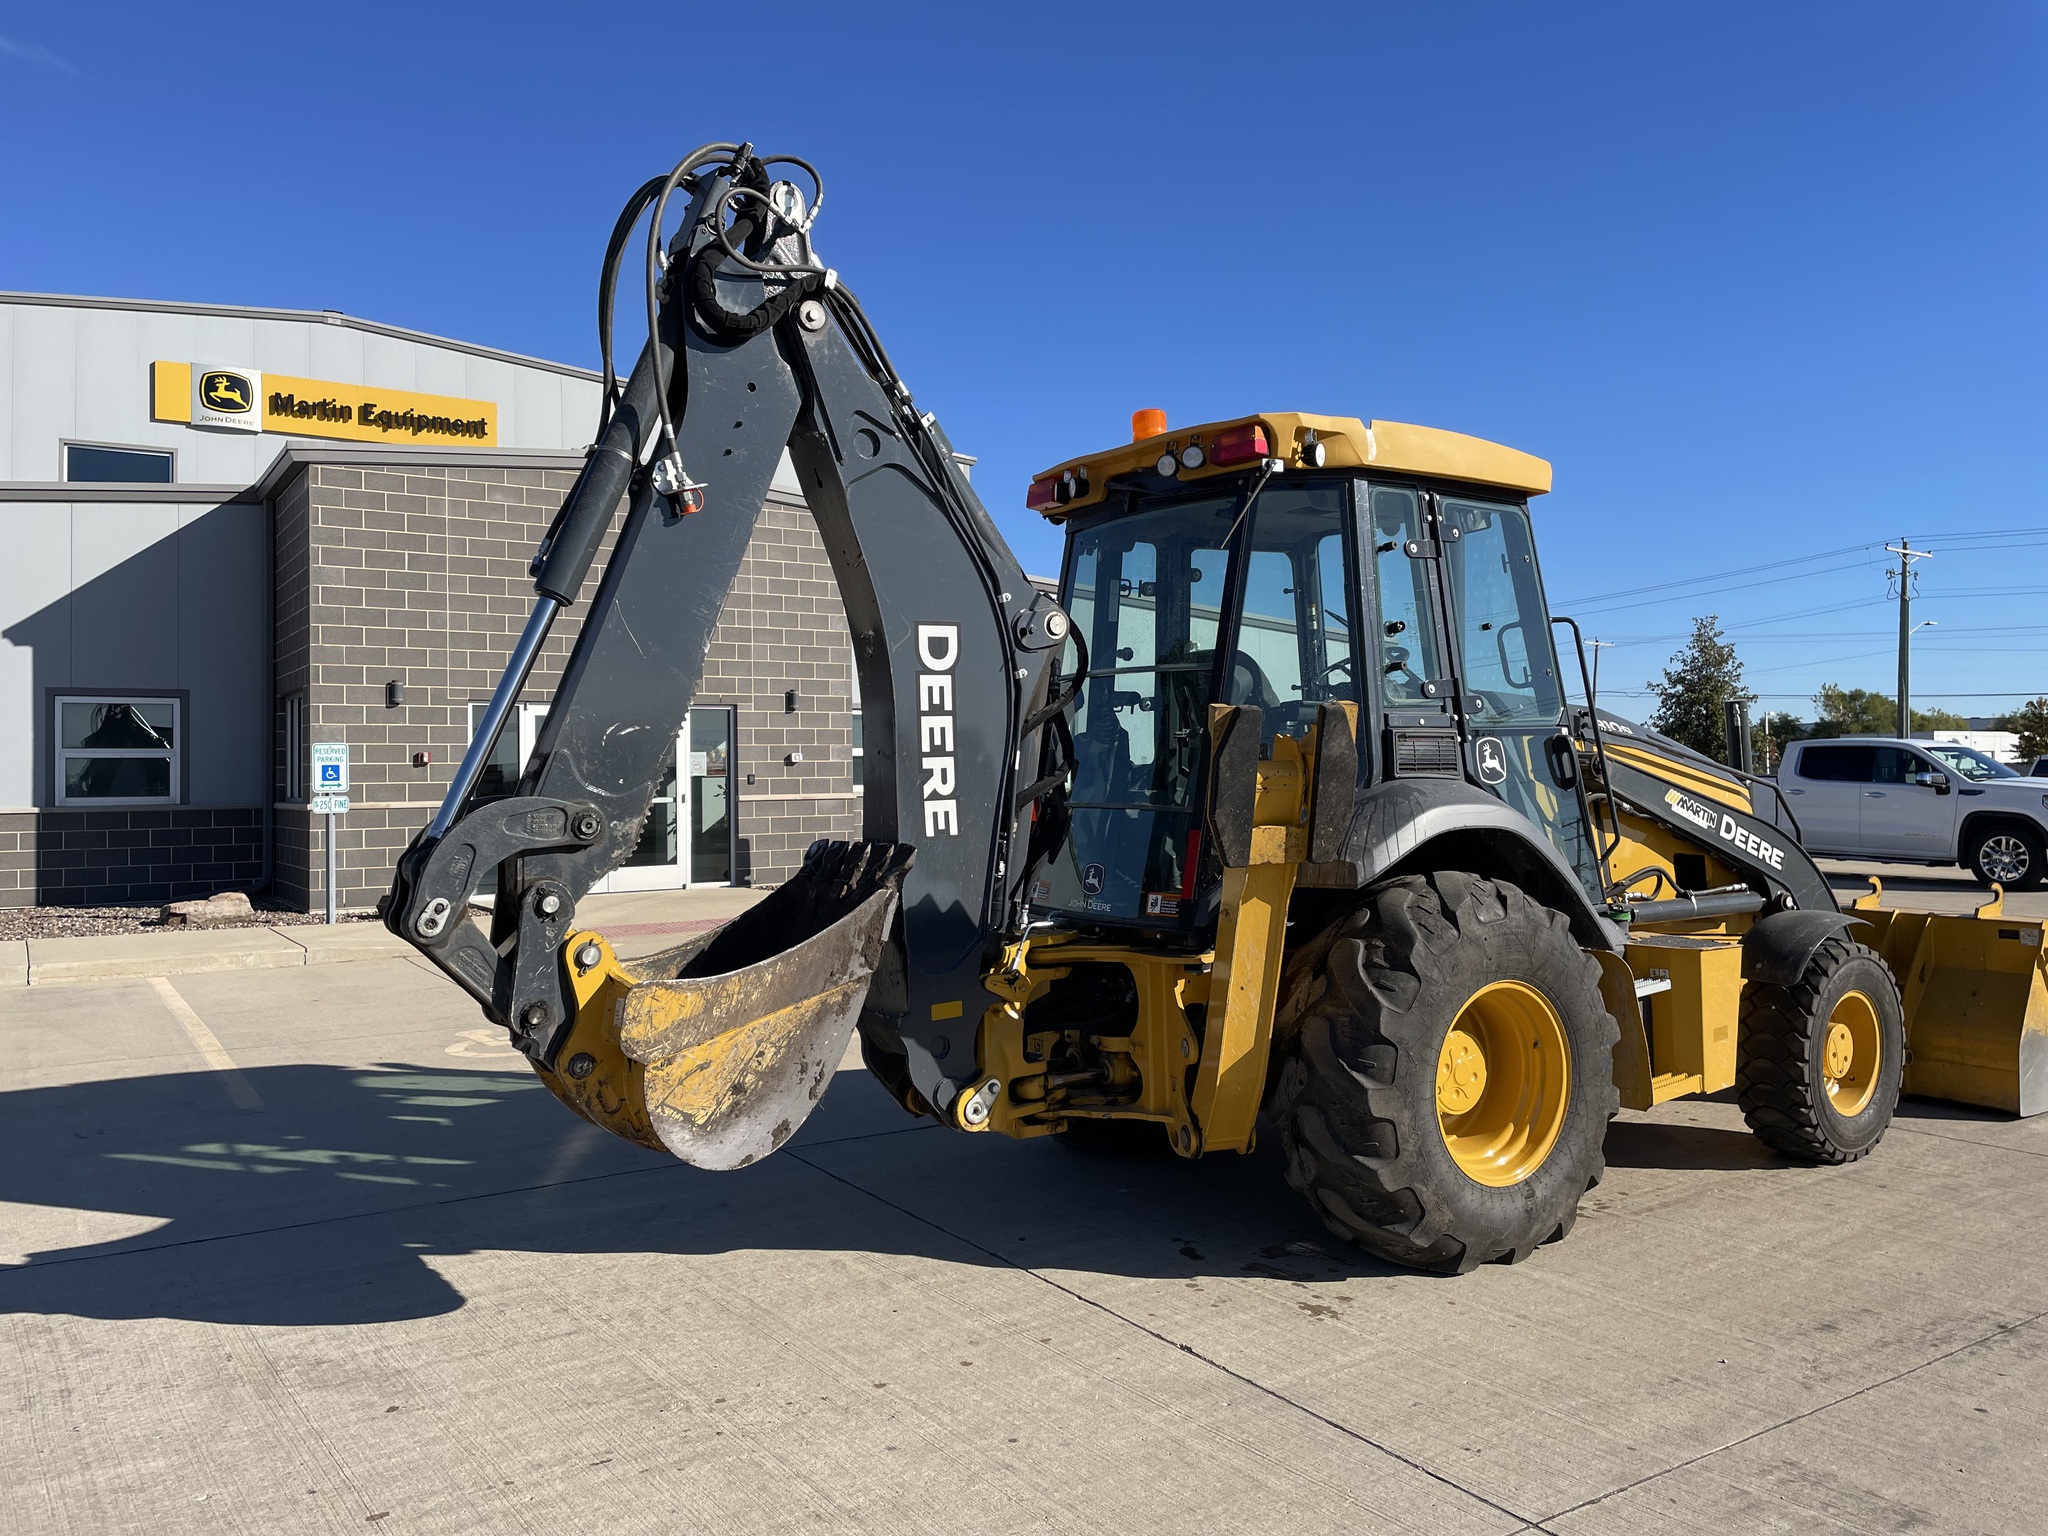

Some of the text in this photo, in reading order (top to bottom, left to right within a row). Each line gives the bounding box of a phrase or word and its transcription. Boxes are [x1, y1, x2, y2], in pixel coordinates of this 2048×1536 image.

[199, 415, 255, 427] JOHN DEERE
[270, 392, 489, 439] Martin Equipment
[917, 624, 959, 838] DEERE
[314, 747, 346, 755] RESERVED
[334, 799, 348, 809] FINE
[1676, 795, 1717, 827] MARTIN
[1719, 813, 1786, 871] DEERE
[1068, 898, 1112, 912] JOHN DEERE
